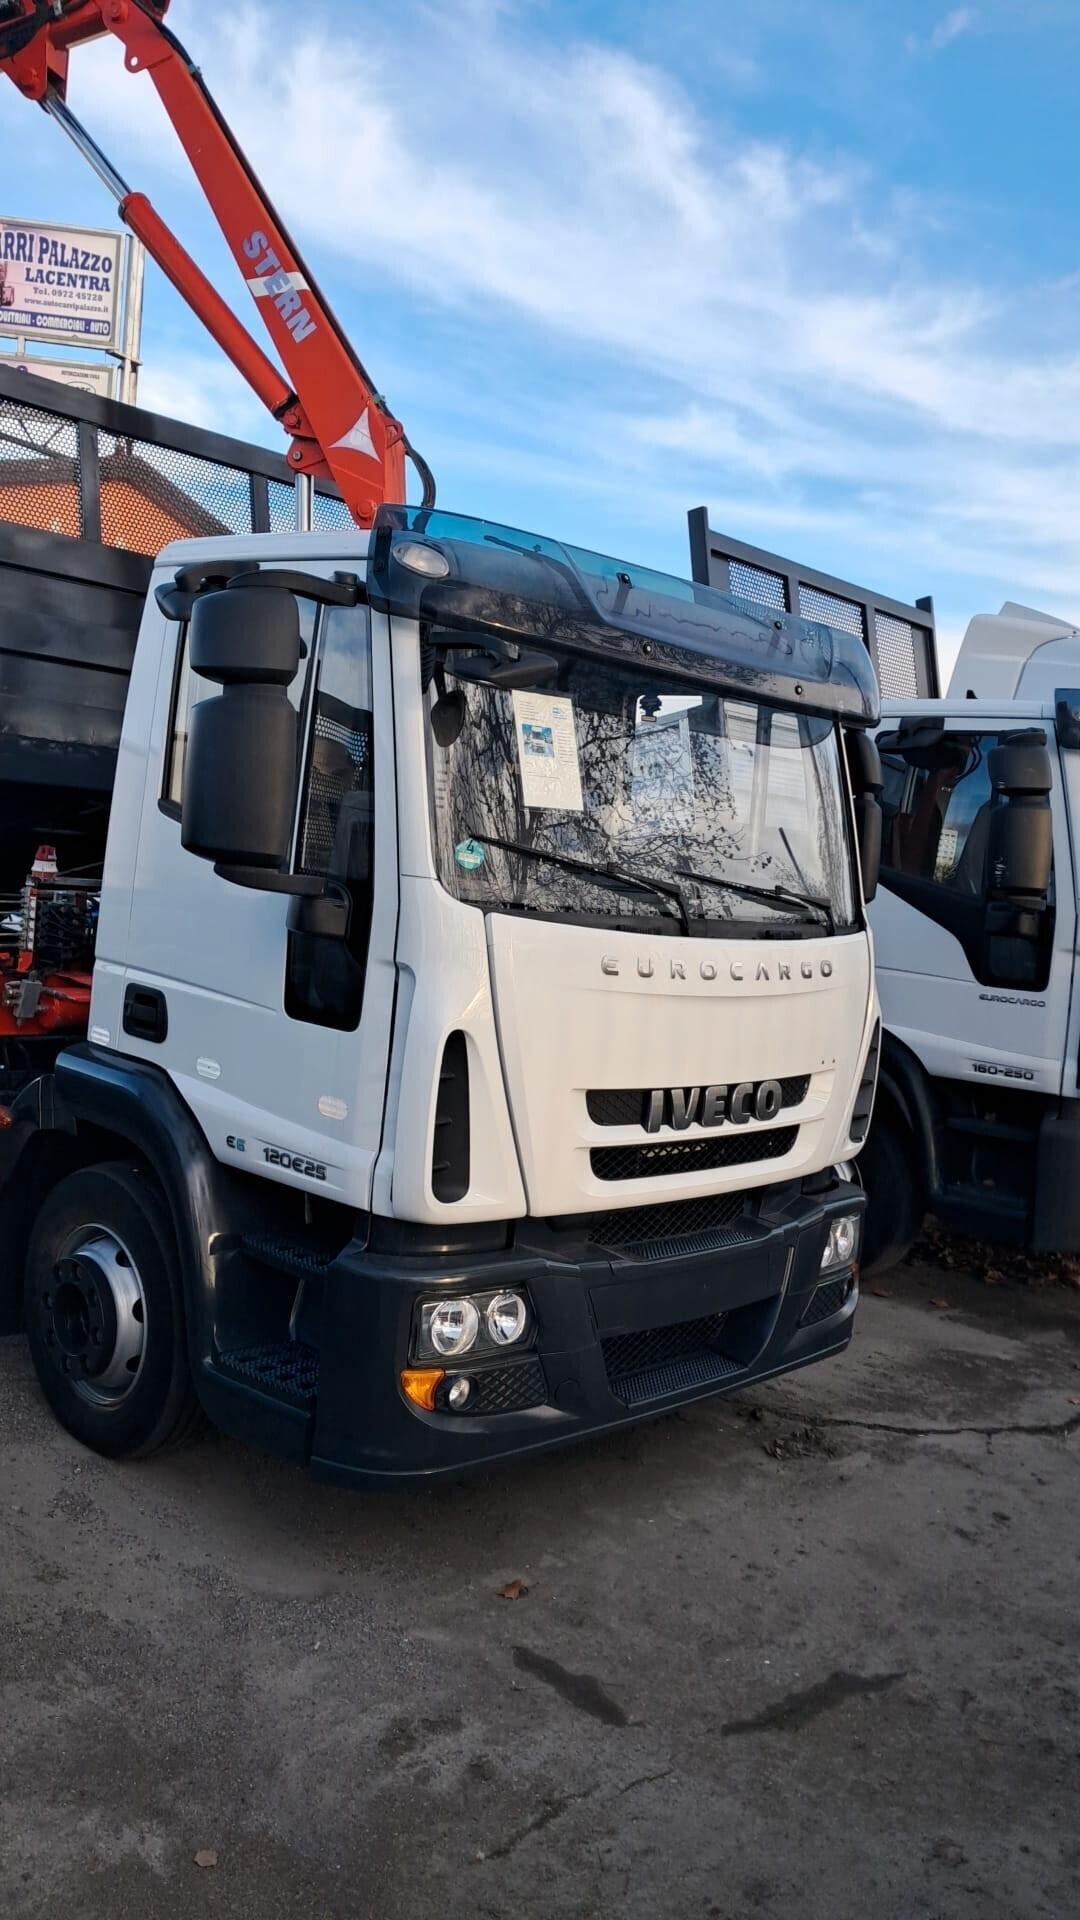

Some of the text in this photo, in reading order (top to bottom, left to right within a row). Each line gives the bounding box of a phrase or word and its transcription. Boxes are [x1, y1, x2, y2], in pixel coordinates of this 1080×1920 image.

[0, 231, 112, 273] RRI PALAZZO
[25, 267, 110, 292] LACENTRA
[243, 230, 317, 343] STERN
[33, 287, 49, 296] Tel.
[52, 288, 73, 299] 0972
[90, 321, 109, 335] AUTO
[600, 954, 833, 981] EUROCARGO
[979, 993, 1046, 1008] EUROCARGO
[972, 1062, 1034, 1081] 160-250
[647, 1080, 783, 1134] IVECO
[263, 1147, 327, 1181] 120E25
